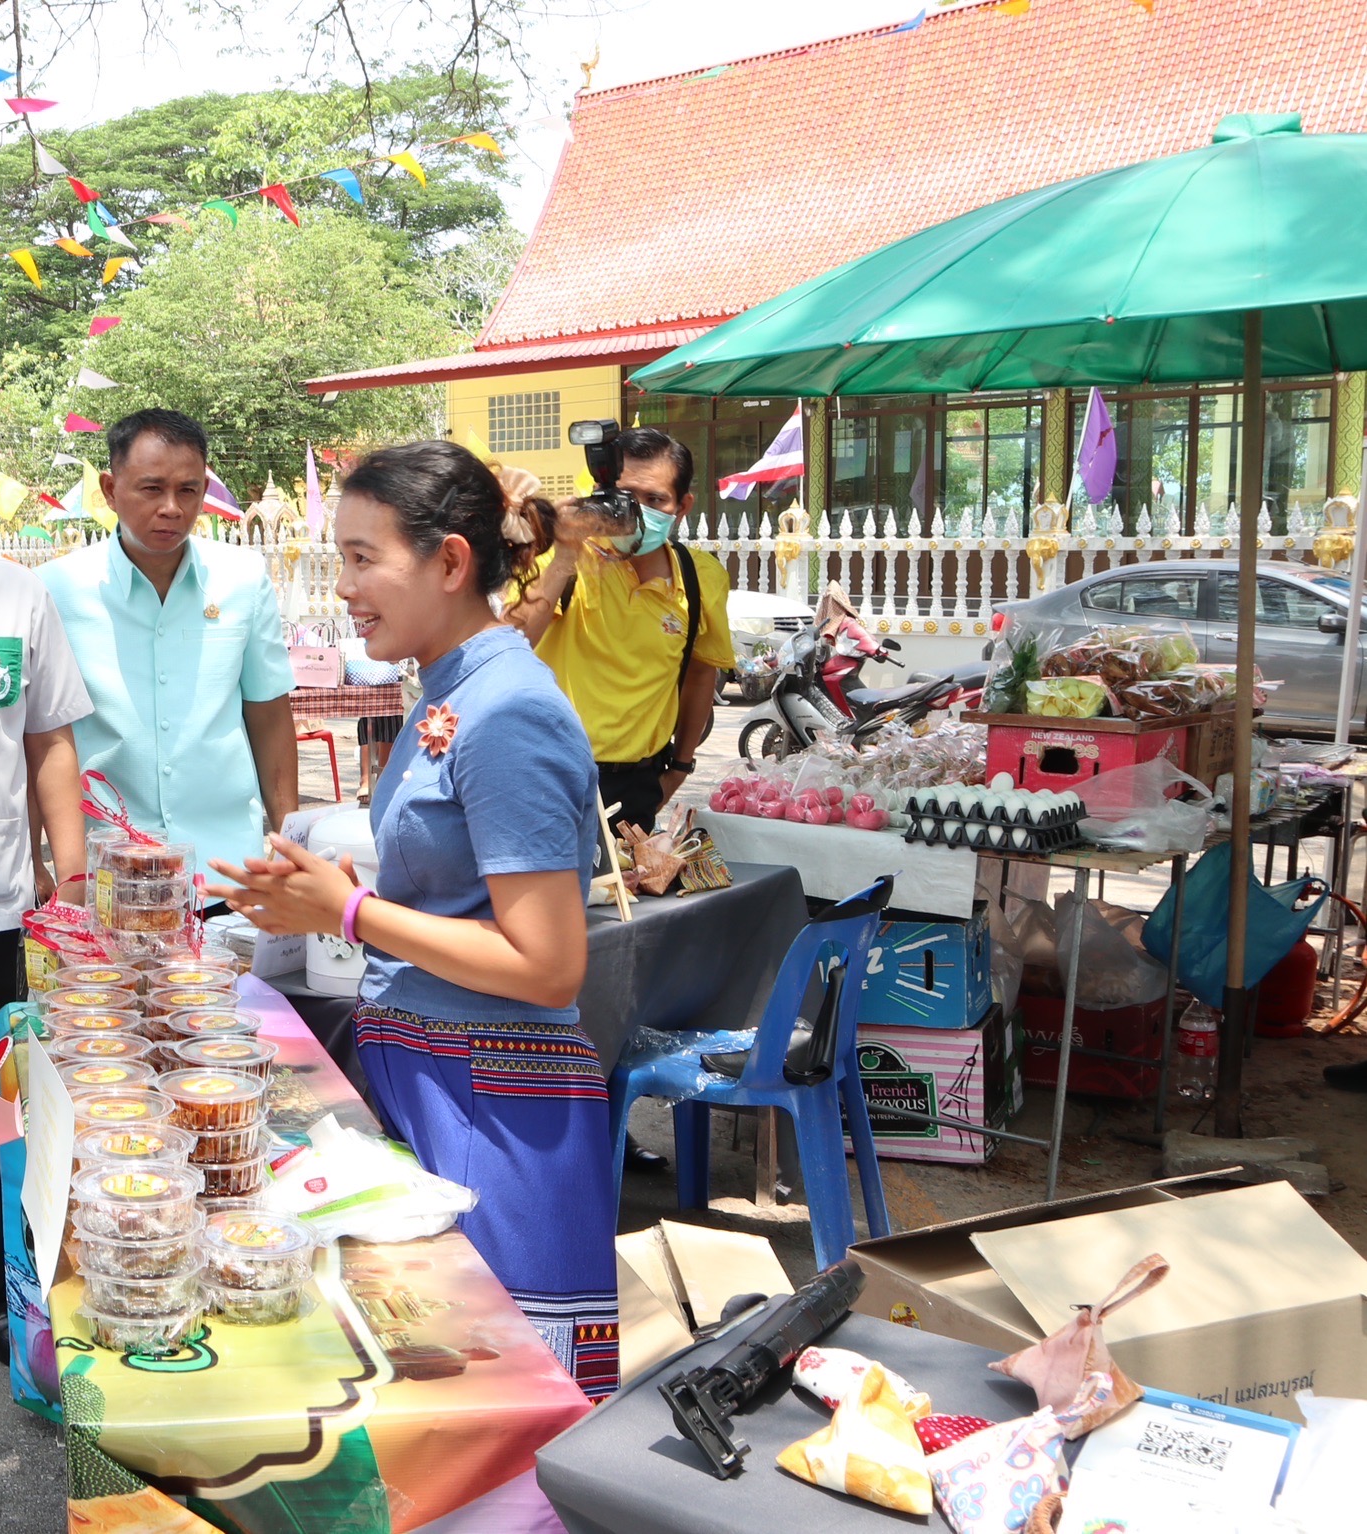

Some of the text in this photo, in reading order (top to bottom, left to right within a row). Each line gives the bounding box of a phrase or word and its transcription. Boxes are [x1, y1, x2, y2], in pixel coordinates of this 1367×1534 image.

[1031, 731, 1095, 742] NEW ZEALAND
[871, 1083, 917, 1097] French
[1235, 1369, 1316, 1404] แม่สมบูรณ์
